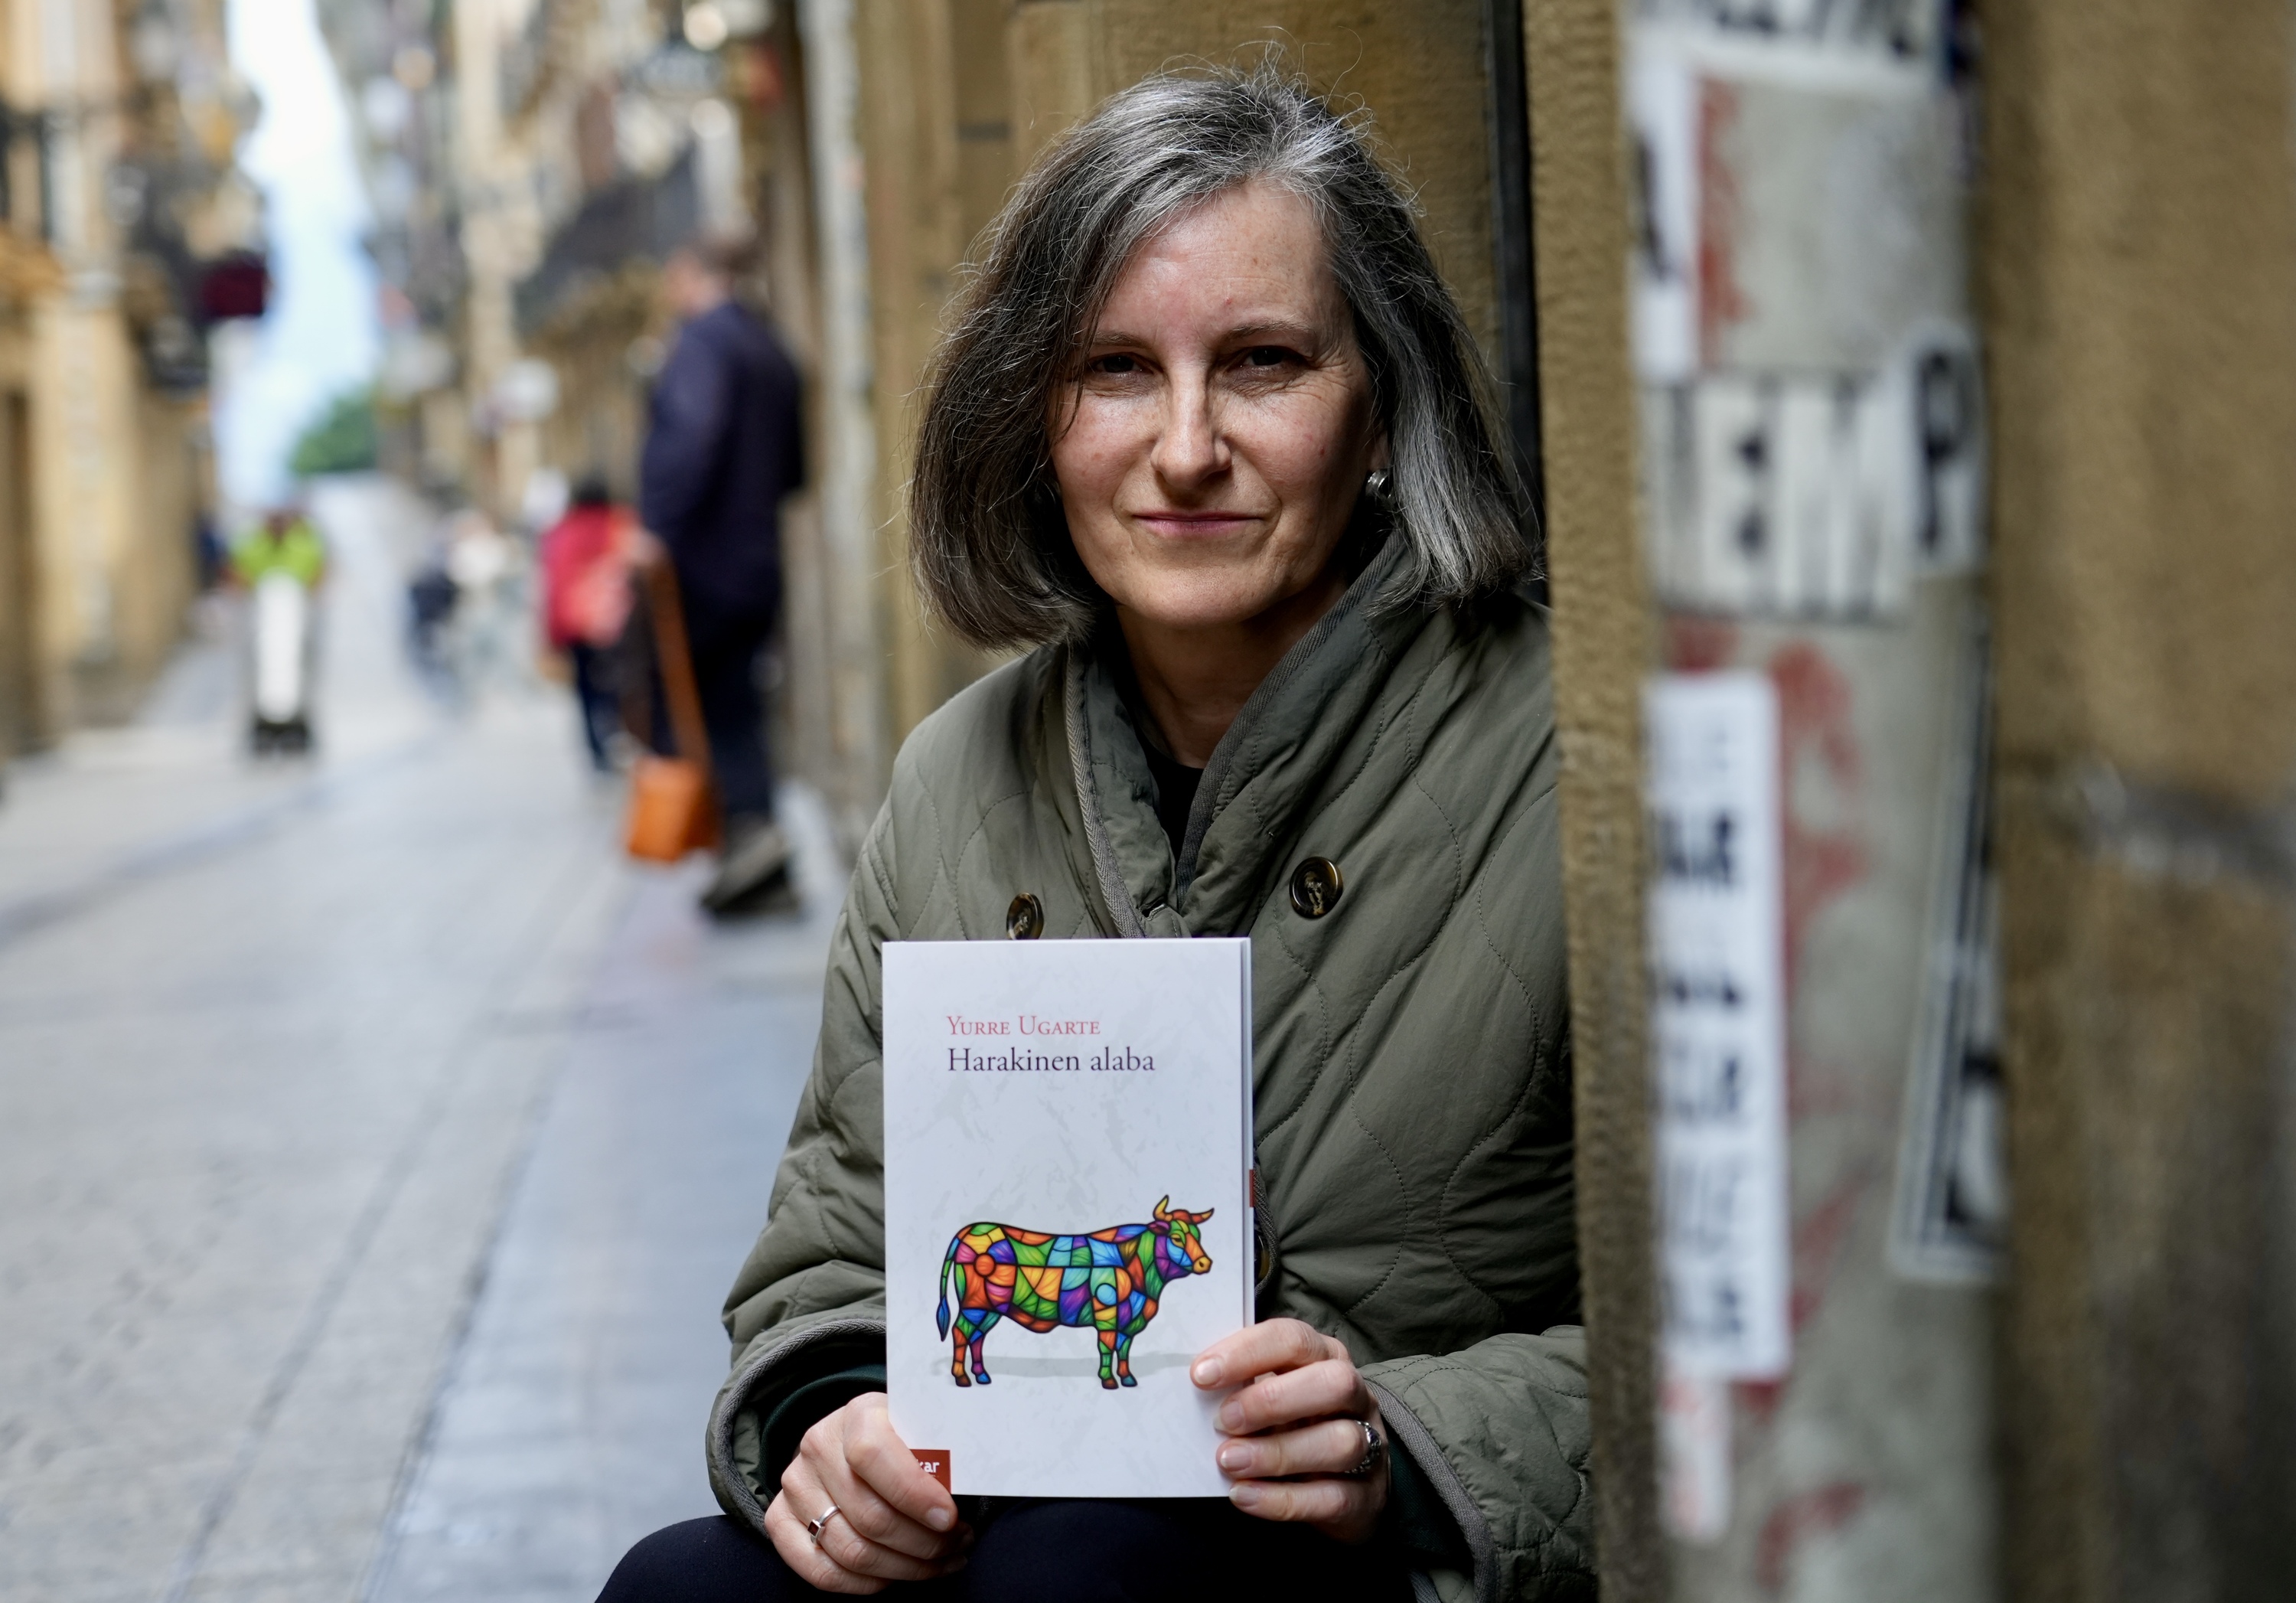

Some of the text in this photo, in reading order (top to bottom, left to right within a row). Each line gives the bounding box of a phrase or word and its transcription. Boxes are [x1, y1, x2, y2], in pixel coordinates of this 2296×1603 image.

[947, 1015, 1101, 1036] YURRE UGARTE
[948, 1046, 1156, 1072] Harakinen alaba
